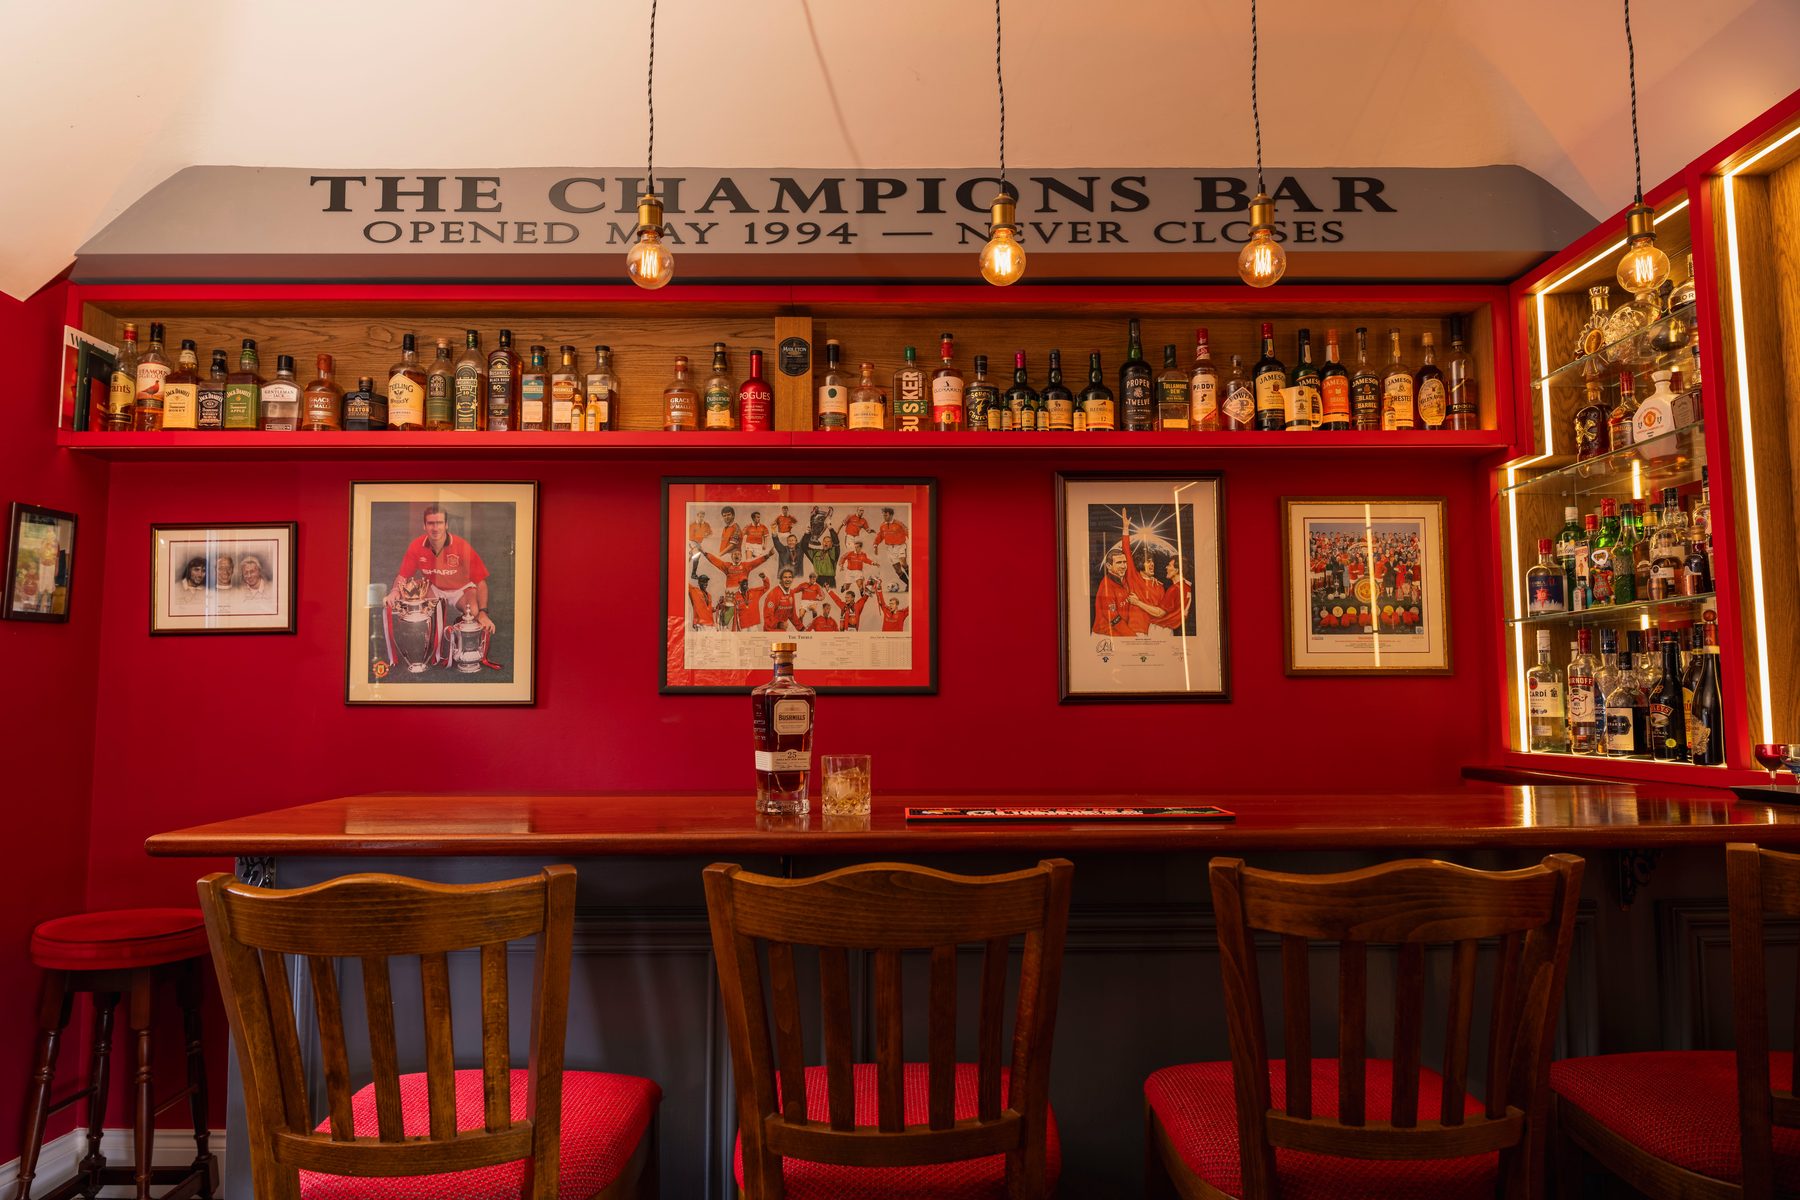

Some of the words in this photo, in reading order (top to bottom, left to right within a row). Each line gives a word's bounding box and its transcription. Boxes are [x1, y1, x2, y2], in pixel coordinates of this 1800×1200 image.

[310, 176, 503, 213] THE
[549, 176, 1150, 214] CHAMPIONS
[1194, 176, 1398, 213] BAR
[363, 220, 580, 245] OPENED
[606, 221, 719, 245] MAY
[744, 221, 858, 245] 1994
[1154, 220, 1344, 245] CLOSES
[1126, 378, 1150, 389] PROPER
[1352, 377, 1379, 388] JAMESON
[1387, 377, 1412, 387] JAMESON
[390, 383, 413, 393] TEELING
[740, 391, 771, 401] POGUES
[902, 371, 919, 431] BUSKER
[1128, 398, 1150, 406] TWELVE
[422, 568, 458, 576] SHARP
